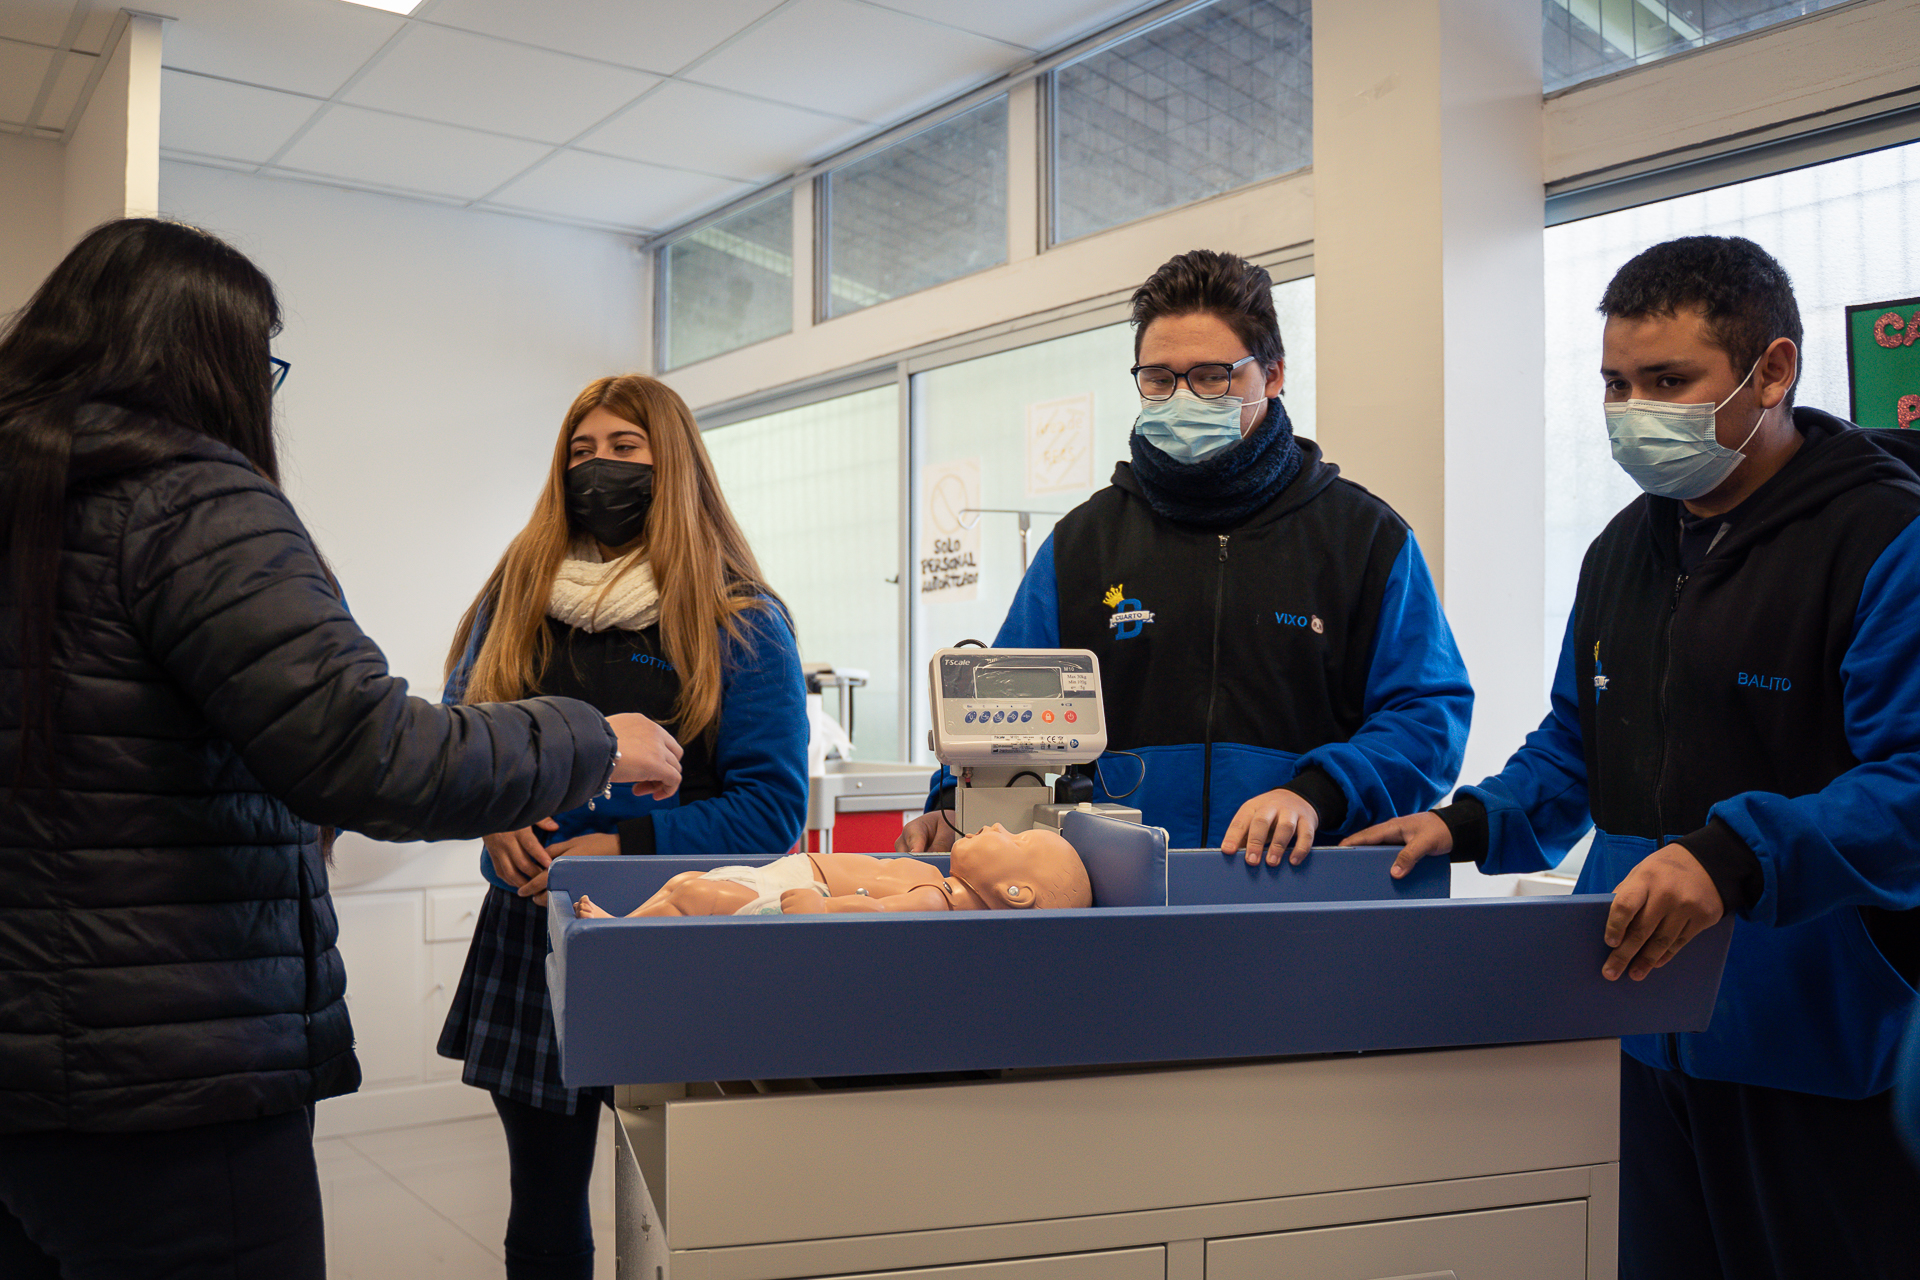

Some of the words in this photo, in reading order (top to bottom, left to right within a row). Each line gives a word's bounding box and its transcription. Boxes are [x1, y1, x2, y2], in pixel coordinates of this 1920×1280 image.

[1115, 612, 1142, 621] CUARTO
[1275, 611, 1308, 627] VIXO
[1737, 671, 1791, 691] BALITO
